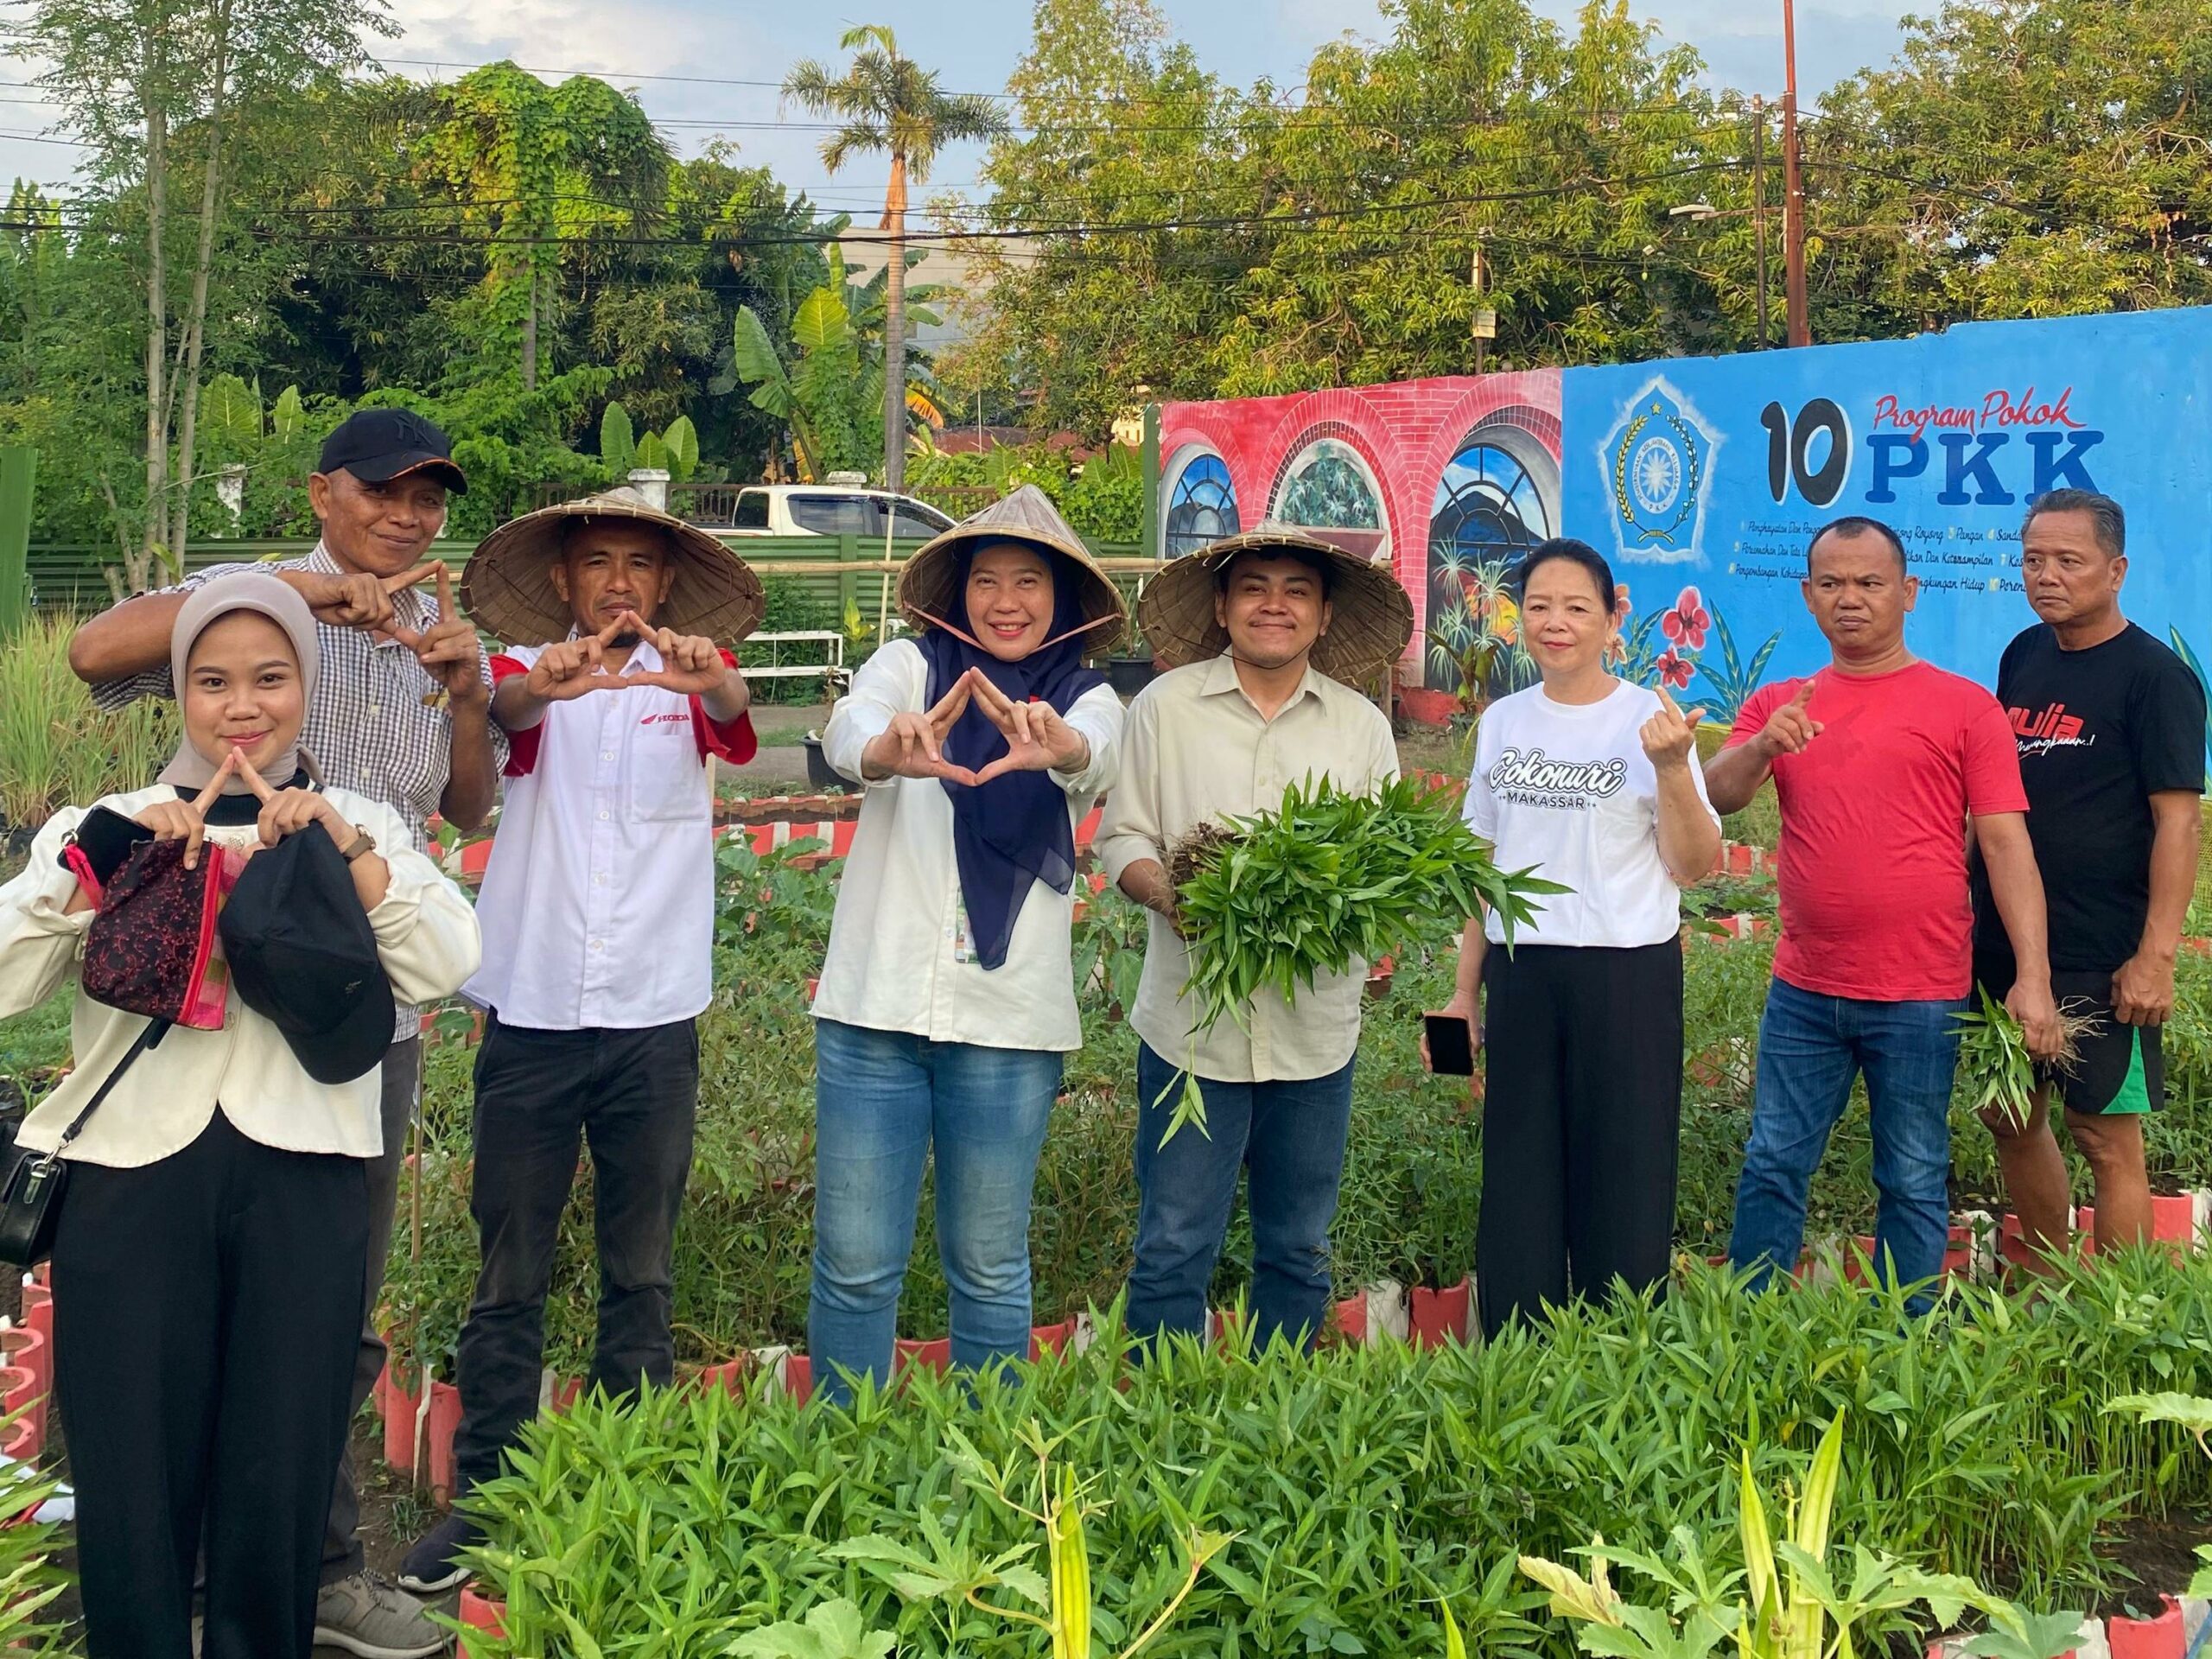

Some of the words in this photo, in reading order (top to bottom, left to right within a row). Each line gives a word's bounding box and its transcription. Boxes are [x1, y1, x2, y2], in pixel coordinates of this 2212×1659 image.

[1873, 395, 1976, 444] Program
[1980, 386, 2087, 429] Pokok
[1760, 397, 1851, 508] 10
[1865, 430, 2109, 506] PKK
[1914, 525, 1944, 545] Royong
[1955, 526, 1984, 545] Pangan
[1925, 550, 1940, 563] Dan
[1960, 576, 1986, 595] Hidup
[1489, 747, 1628, 799] Cokonuri
[1506, 791, 1586, 810] MAKASSAR
